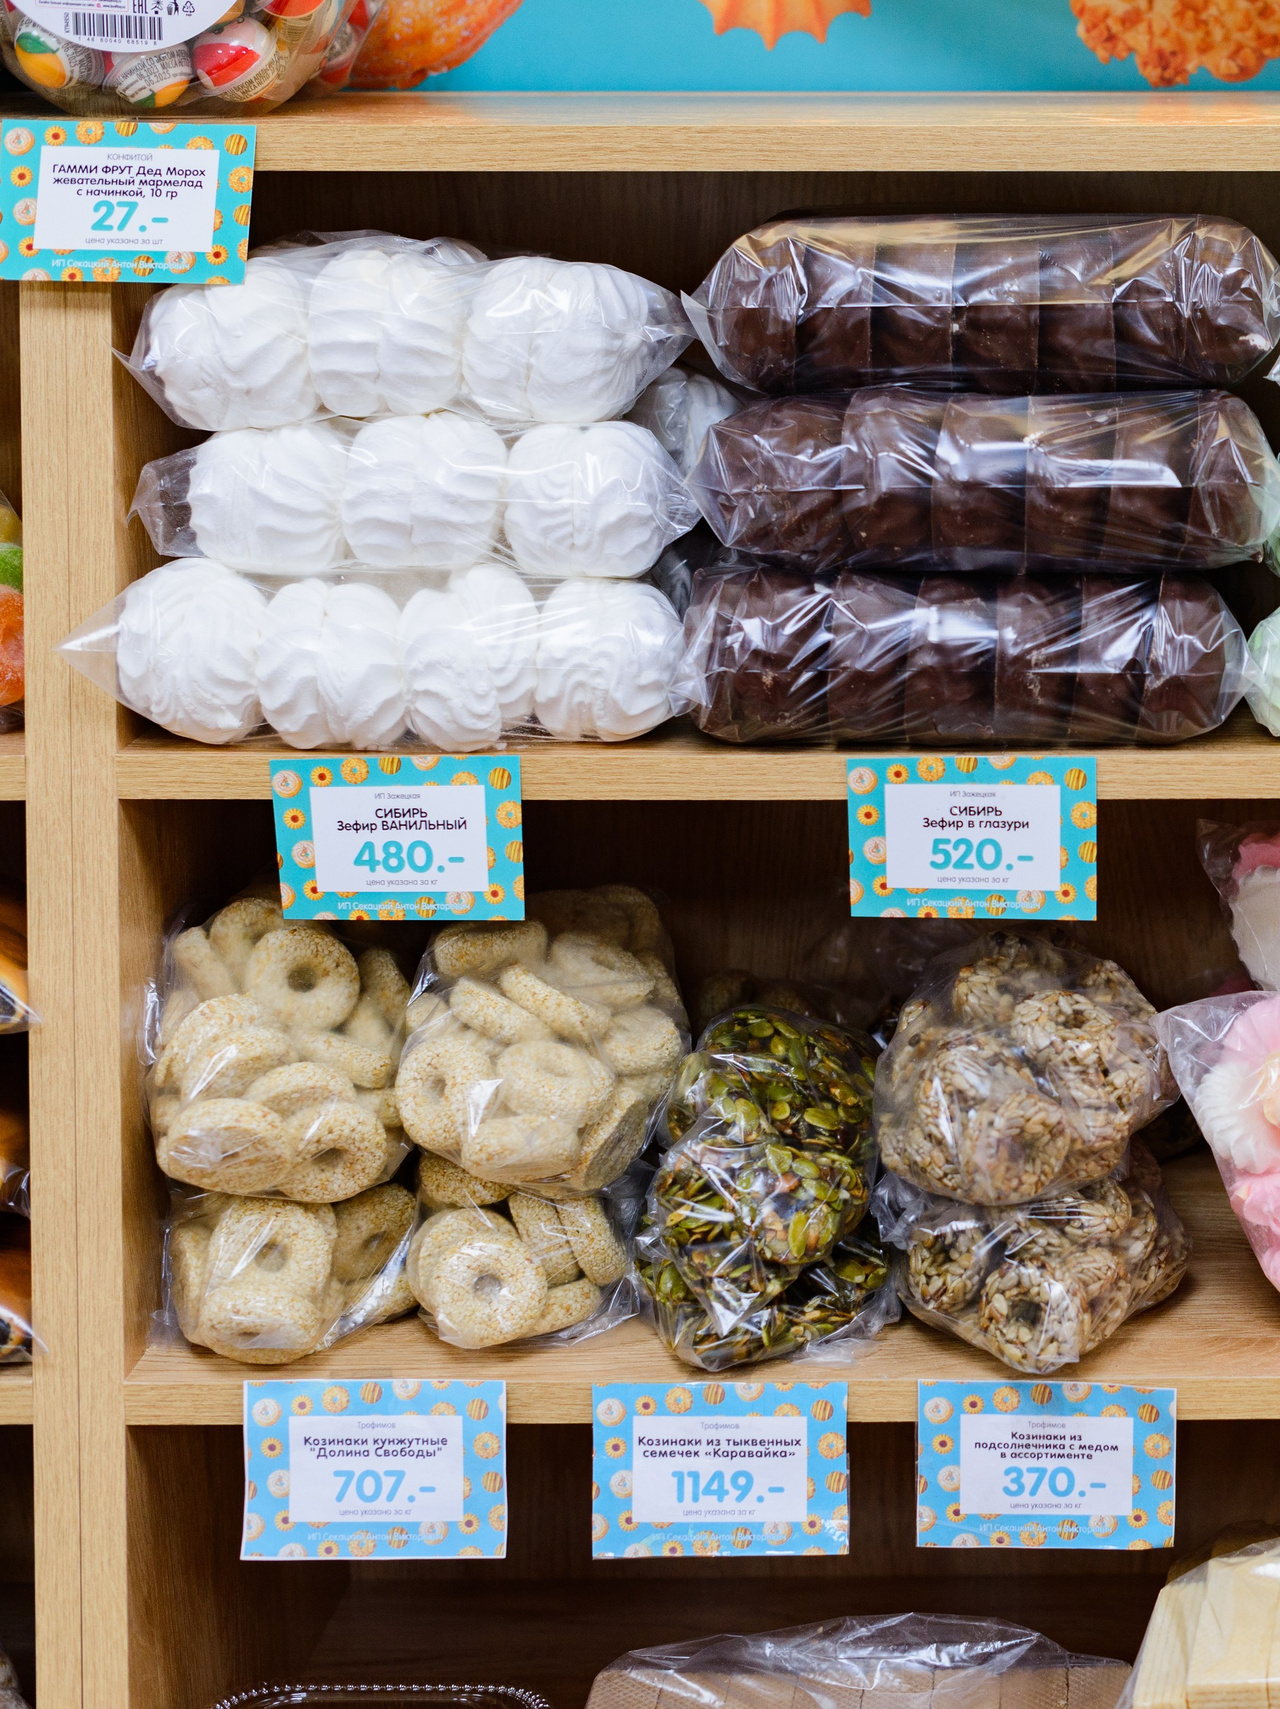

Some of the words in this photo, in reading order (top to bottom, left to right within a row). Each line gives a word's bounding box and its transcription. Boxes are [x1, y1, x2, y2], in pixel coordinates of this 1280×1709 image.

[145, 70, 171, 86] 06.2025
[107, 153, 153, 161] КОНФИТОЙ
[52, 164, 98, 174] ГАММИ
[102, 166, 133, 175] ФРУТ
[136, 167, 162, 176] Дед
[166, 168, 206, 177] Морох
[53, 177, 135, 186] жевательный
[139, 179, 203, 188] мармелад
[86, 188, 146, 198] начинкой,
[151, 189, 162, 197] 10
[166, 190, 178, 200] гр
[91, 200, 169, 233] 27.-
[52, 259, 66, 267] ИП
[67, 260, 109, 269] Секацкий
[112, 261, 137, 269] Антон
[139, 262, 190, 270] Викторович
[375, 808, 428, 819] СИБИРЬ
[950, 806, 1002, 816] СИБИРЬ
[337, 820, 377, 833] Зефир
[382, 817, 467, 830] ВАНИЛЬНЫЙ
[923, 817, 963, 830] Зефир
[979, 820, 1029, 831] глазури
[353, 840, 465, 873] 480.-
[930, 838, 1034, 871] 520.-
[357, 1422, 396, 1430] Трофимов
[701, 1422, 740, 1430] Трофимов
[1028, 1421, 1066, 1429] Трофимов
[303, 1436, 368, 1446] Козинаки
[373, 1437, 448, 1448] кунжутные
[638, 1436, 701, 1446] Козинаки
[706, 1438, 721, 1446] из
[726, 1438, 802, 1446] тыквенных
[1011, 1432, 1065, 1441] Козинаки
[1070, 1433, 1082, 1441] из
[974, 1442, 1065, 1451] подсолнечника
[1079, 1444, 1119, 1452] медом
[310, 1448, 370, 1459] "Долина
[375, 1448, 442, 1459] Свободы"
[643, 1449, 700, 1458] семечек
[705, 1447, 796, 1459] «Каравайка»
[1010, 1452, 1093, 1460] ассортименте
[333, 1470, 436, 1503] 707.-
[671, 1470, 785, 1503] 1149.-
[1002, 1466, 1106, 1498] 370.-
